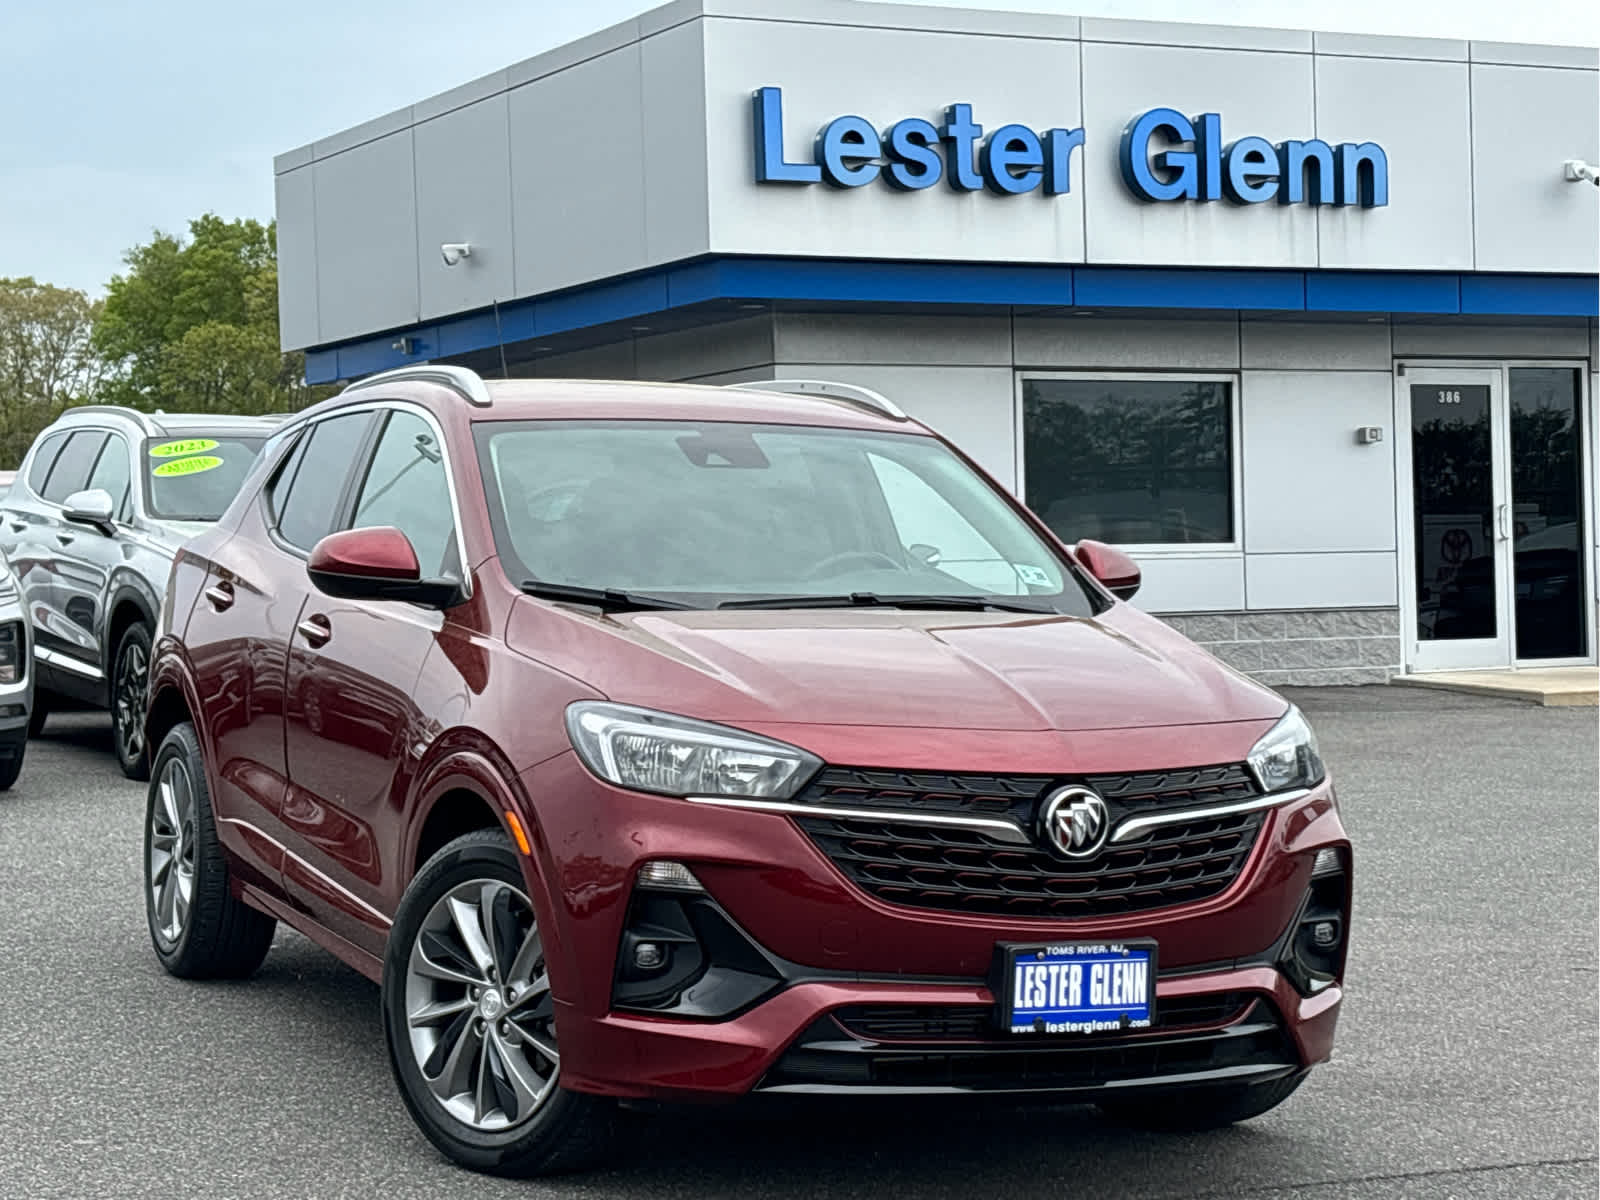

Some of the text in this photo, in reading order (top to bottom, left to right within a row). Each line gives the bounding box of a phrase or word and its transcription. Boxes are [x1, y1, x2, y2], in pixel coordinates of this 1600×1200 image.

[752, 86, 1389, 208] Lester Glenn
[1046, 945, 1075, 956] TOMS
[1014, 961, 1148, 1009] LESTER GLENN
[1045, 1020, 1120, 1034] lesterglenn
